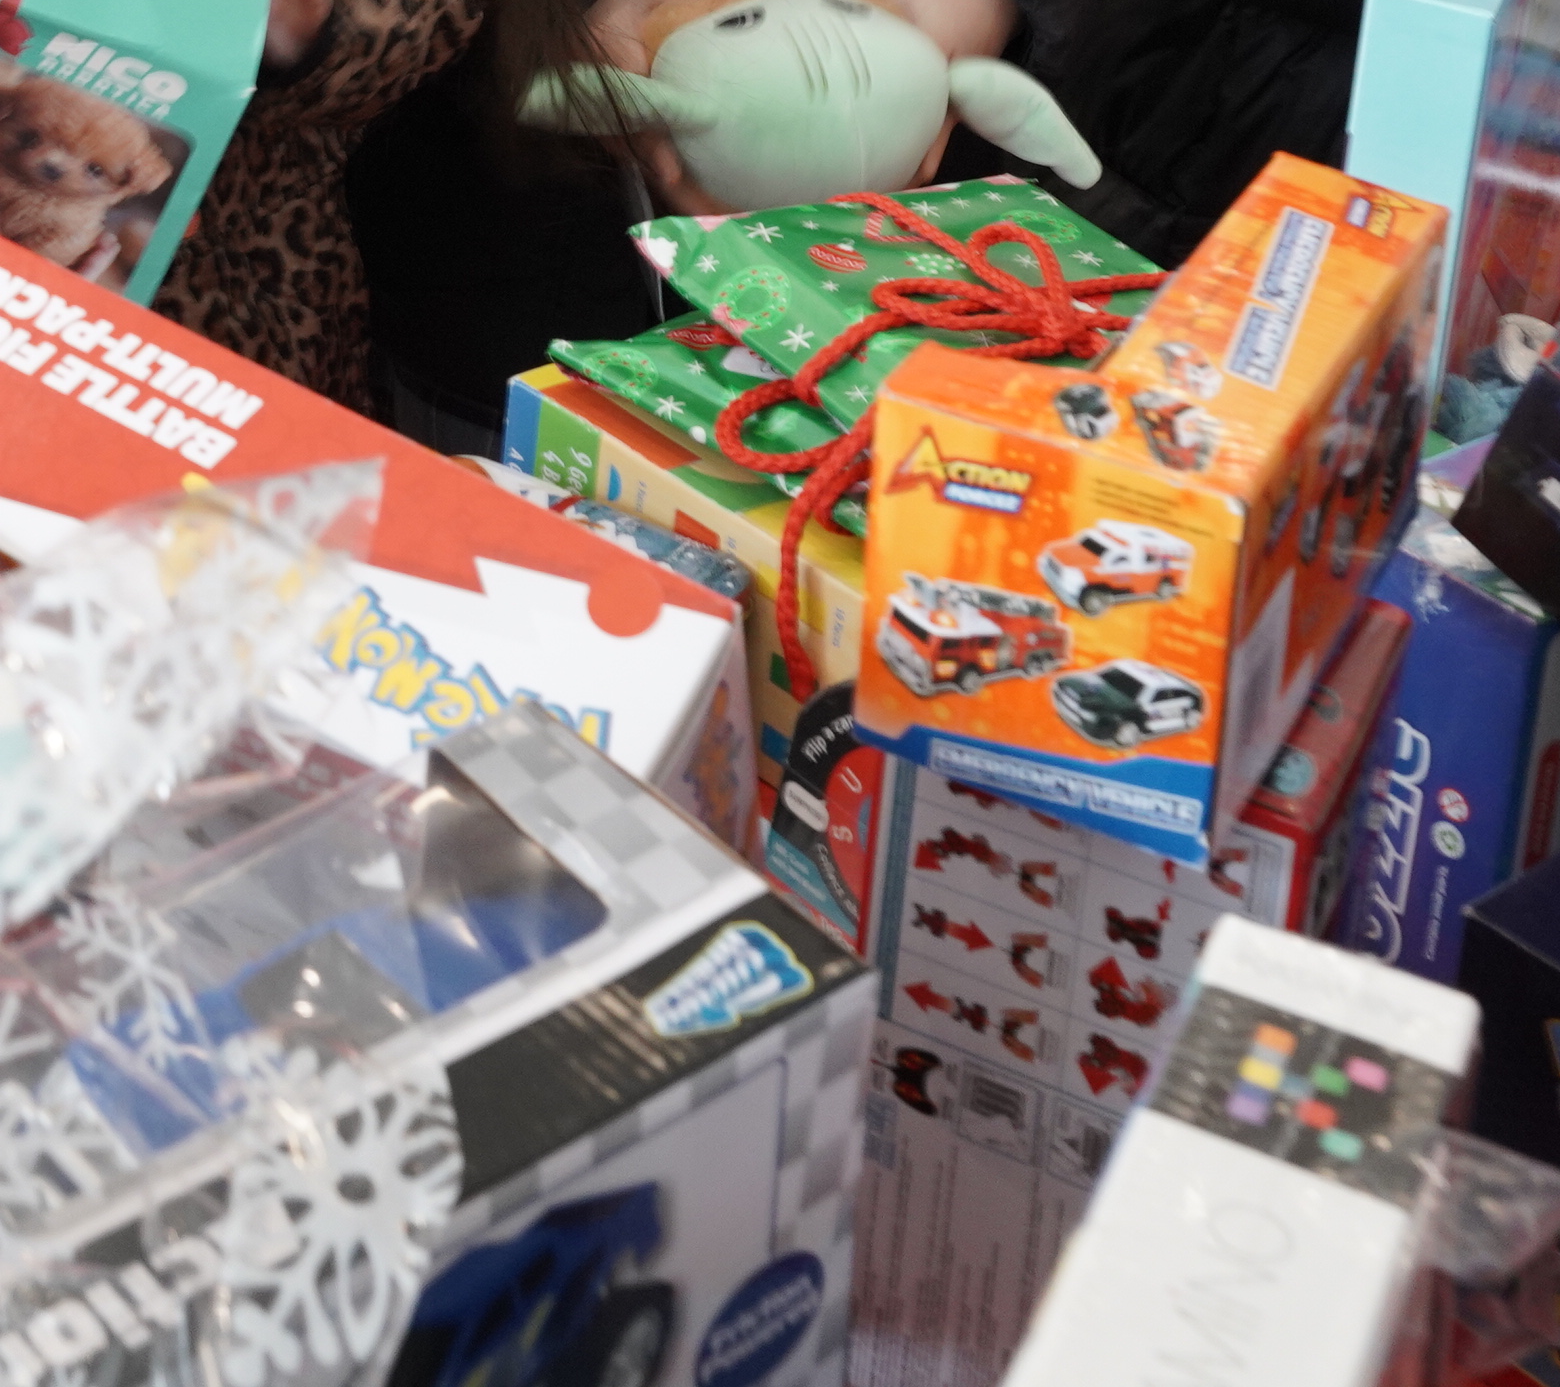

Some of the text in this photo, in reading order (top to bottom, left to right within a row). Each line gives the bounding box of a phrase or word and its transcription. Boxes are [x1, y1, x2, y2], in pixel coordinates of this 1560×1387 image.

[41, 353, 240, 470] BATTLE
[570, 445, 593, 467] 9
[898, 434, 1032, 492] ACTION
[803, 713, 855, 764] Flip a car
